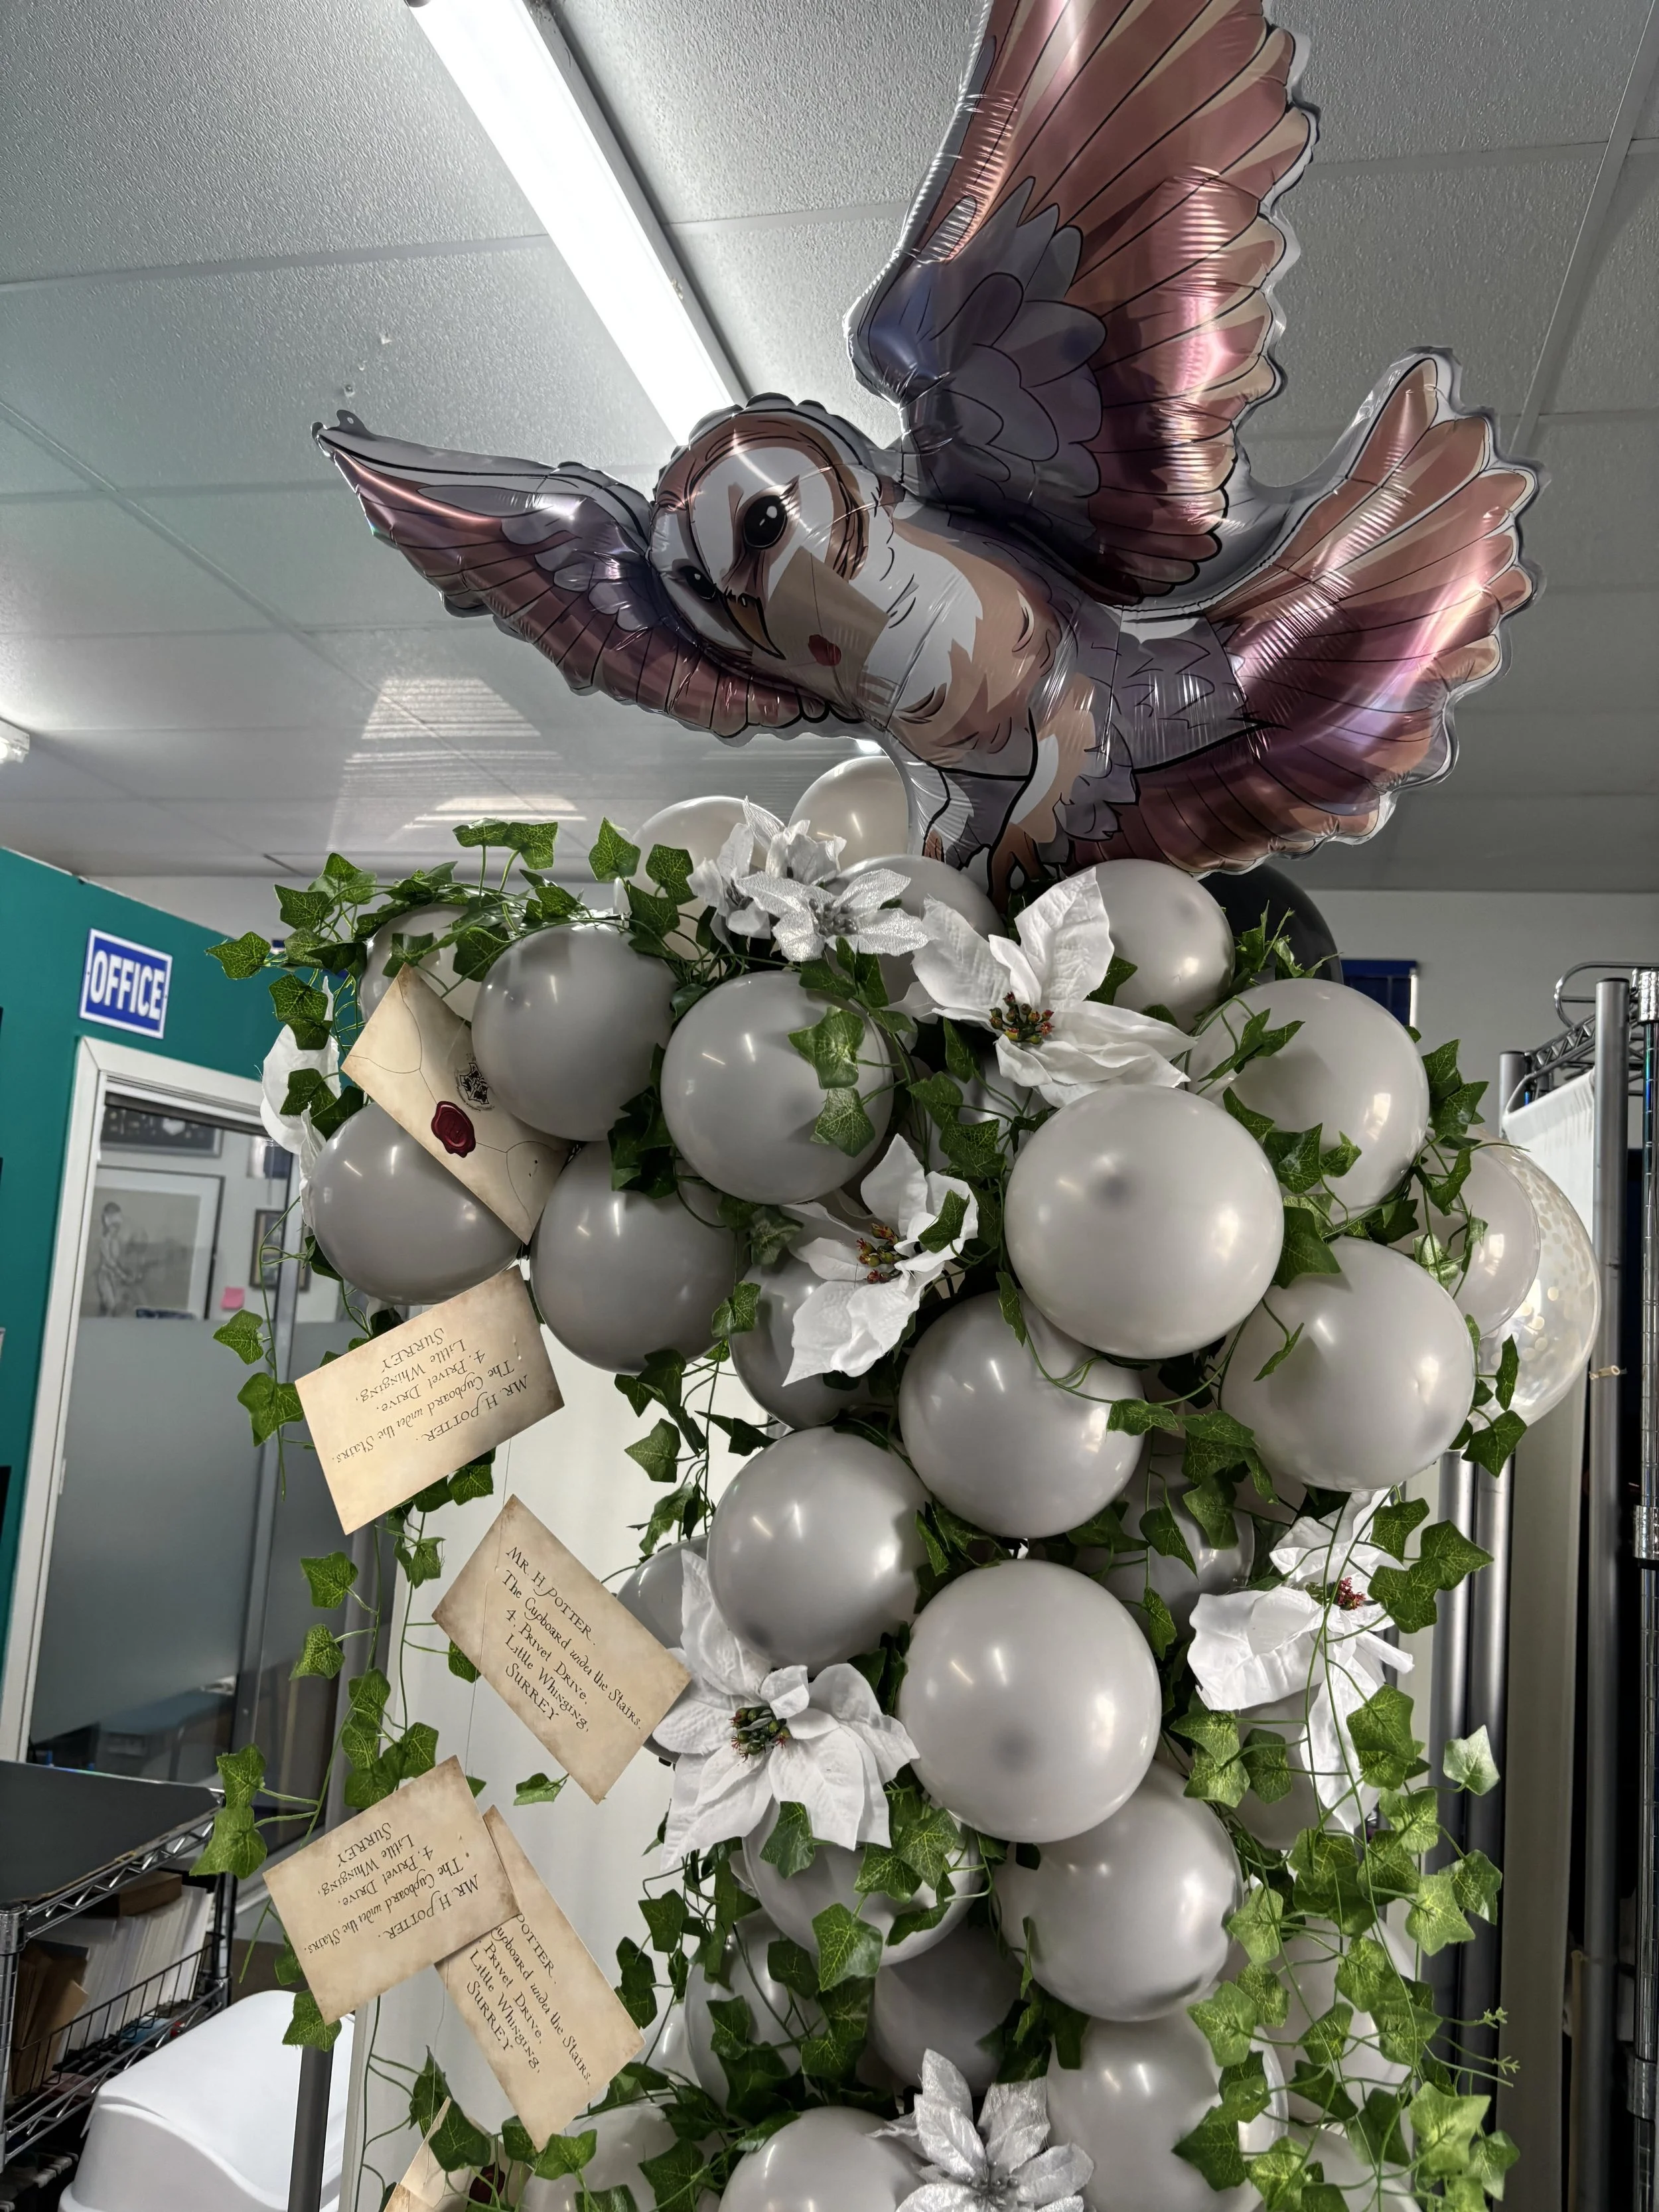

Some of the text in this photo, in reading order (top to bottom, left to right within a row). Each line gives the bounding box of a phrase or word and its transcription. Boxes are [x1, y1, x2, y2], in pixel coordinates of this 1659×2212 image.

[90, 950, 165, 1020] OFFICE
[429, 1339, 467, 1364] Little
[427, 1359, 468, 1389] Privet
[487, 1360, 514, 1378] The
[397, 1408, 423, 1428] under
[377, 1425, 395, 1439] the
[502, 1570, 522, 1599] The
[569, 1650, 592, 1676] under
[593, 1670, 608, 1691] the
[518, 1621, 552, 1662] Privet
[505, 1633, 534, 1670] Little
[381, 1834, 415, 1859] Little
[382, 1854, 419, 1885] Privet
[437, 1857, 464, 1877] The
[342, 1919, 359, 1933] the
[358, 1904, 382, 1923] under
[470, 1949, 494, 1992] Little
[490, 1927, 534, 1981] upboard
[530, 1983, 550, 2015] under
[550, 2012, 563, 2035] the
